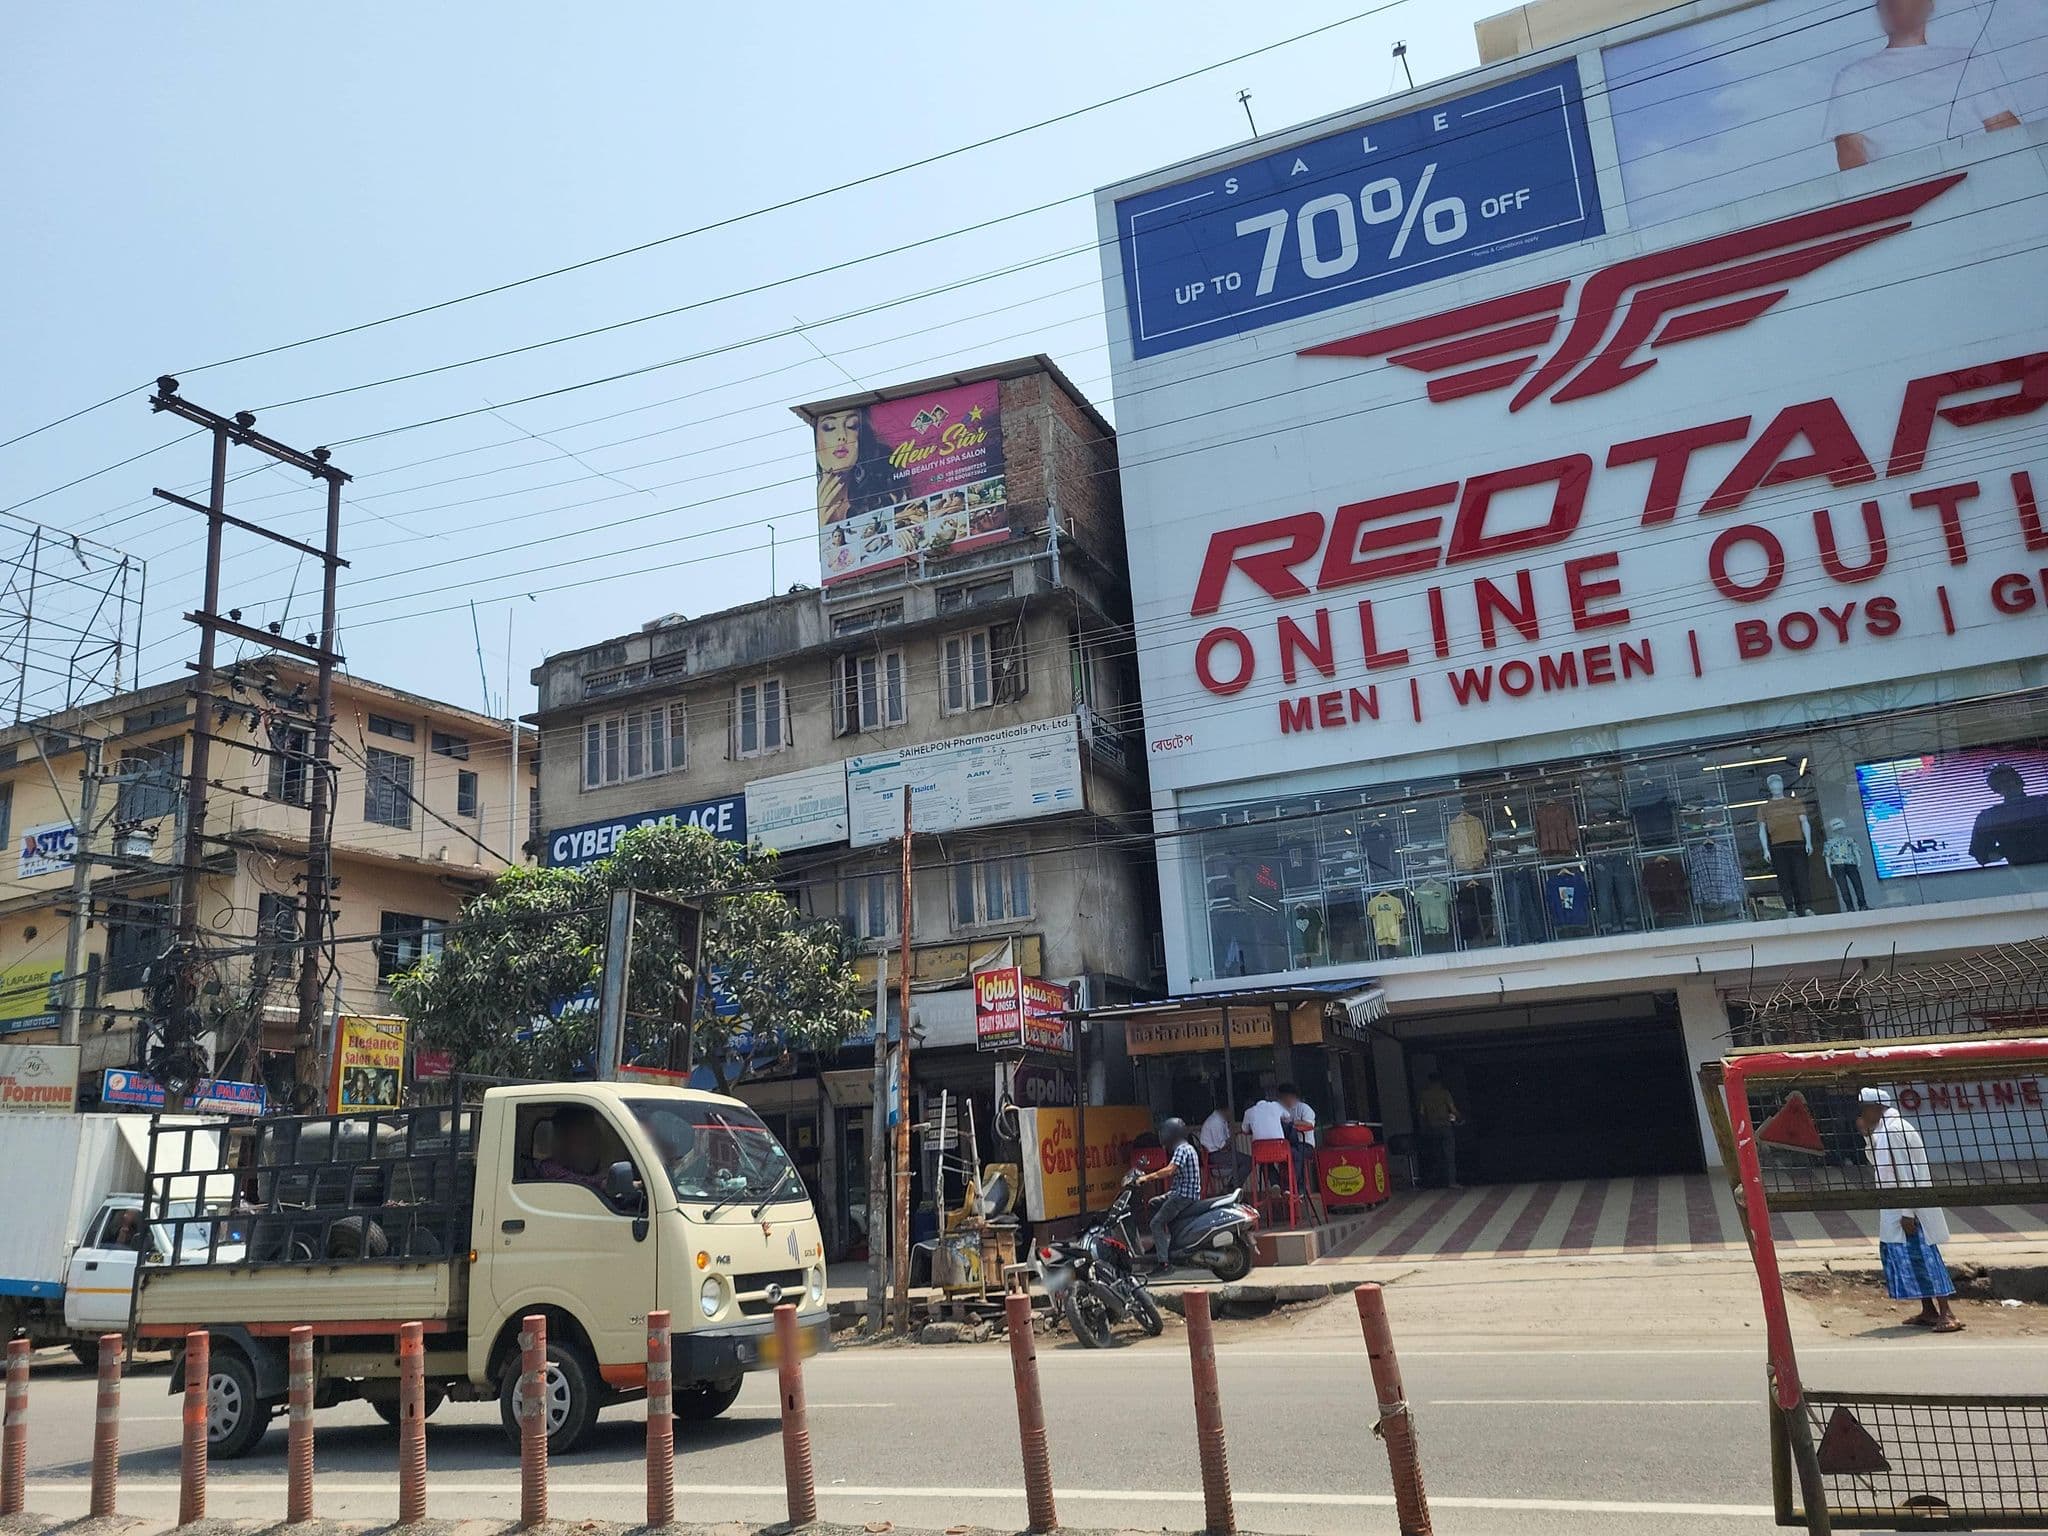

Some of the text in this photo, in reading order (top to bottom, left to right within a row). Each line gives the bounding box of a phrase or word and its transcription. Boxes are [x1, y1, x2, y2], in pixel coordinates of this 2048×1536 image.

[1225, 112, 1449, 194] SALE
[1175, 162, 1531, 305] UP TO 70% OFF
[889, 423, 988, 469] New Star
[893, 470, 911, 481] HAIR
[911, 459, 939, 475] BEAUTY
[945, 454, 961, 465] SPA
[961, 447, 986, 461] SALON
[1196, 551, 1631, 695] ONLINE
[1279, 686, 1380, 733] MEN
[1447, 638, 1656, 706] WOMEN
[1735, 597, 1903, 661] BOYS
[899, 718, 1072, 759] SAIHELPON Pharmacuticals Pvt. Ltd.
[6, 972, 46, 987] LAPCARE
[978, 975, 1017, 1011] Lotus
[979, 1014, 995, 1033] BEAUTY
[995, 1013, 1004, 1031] SPA
[1004, 1011, 1019, 1029] SALON
[995, 1000, 1017, 1012] UNISEX
[345, 1052, 400, 1067] Salon & Spa
[348, 1036, 399, 1051] Elegance
[2, 1086, 73, 1102] FORTUNE
[1026, 1070, 1073, 1106] apollo
[1899, 1080, 2043, 1111] ONLINE
[1052, 1119, 1073, 1146] The
